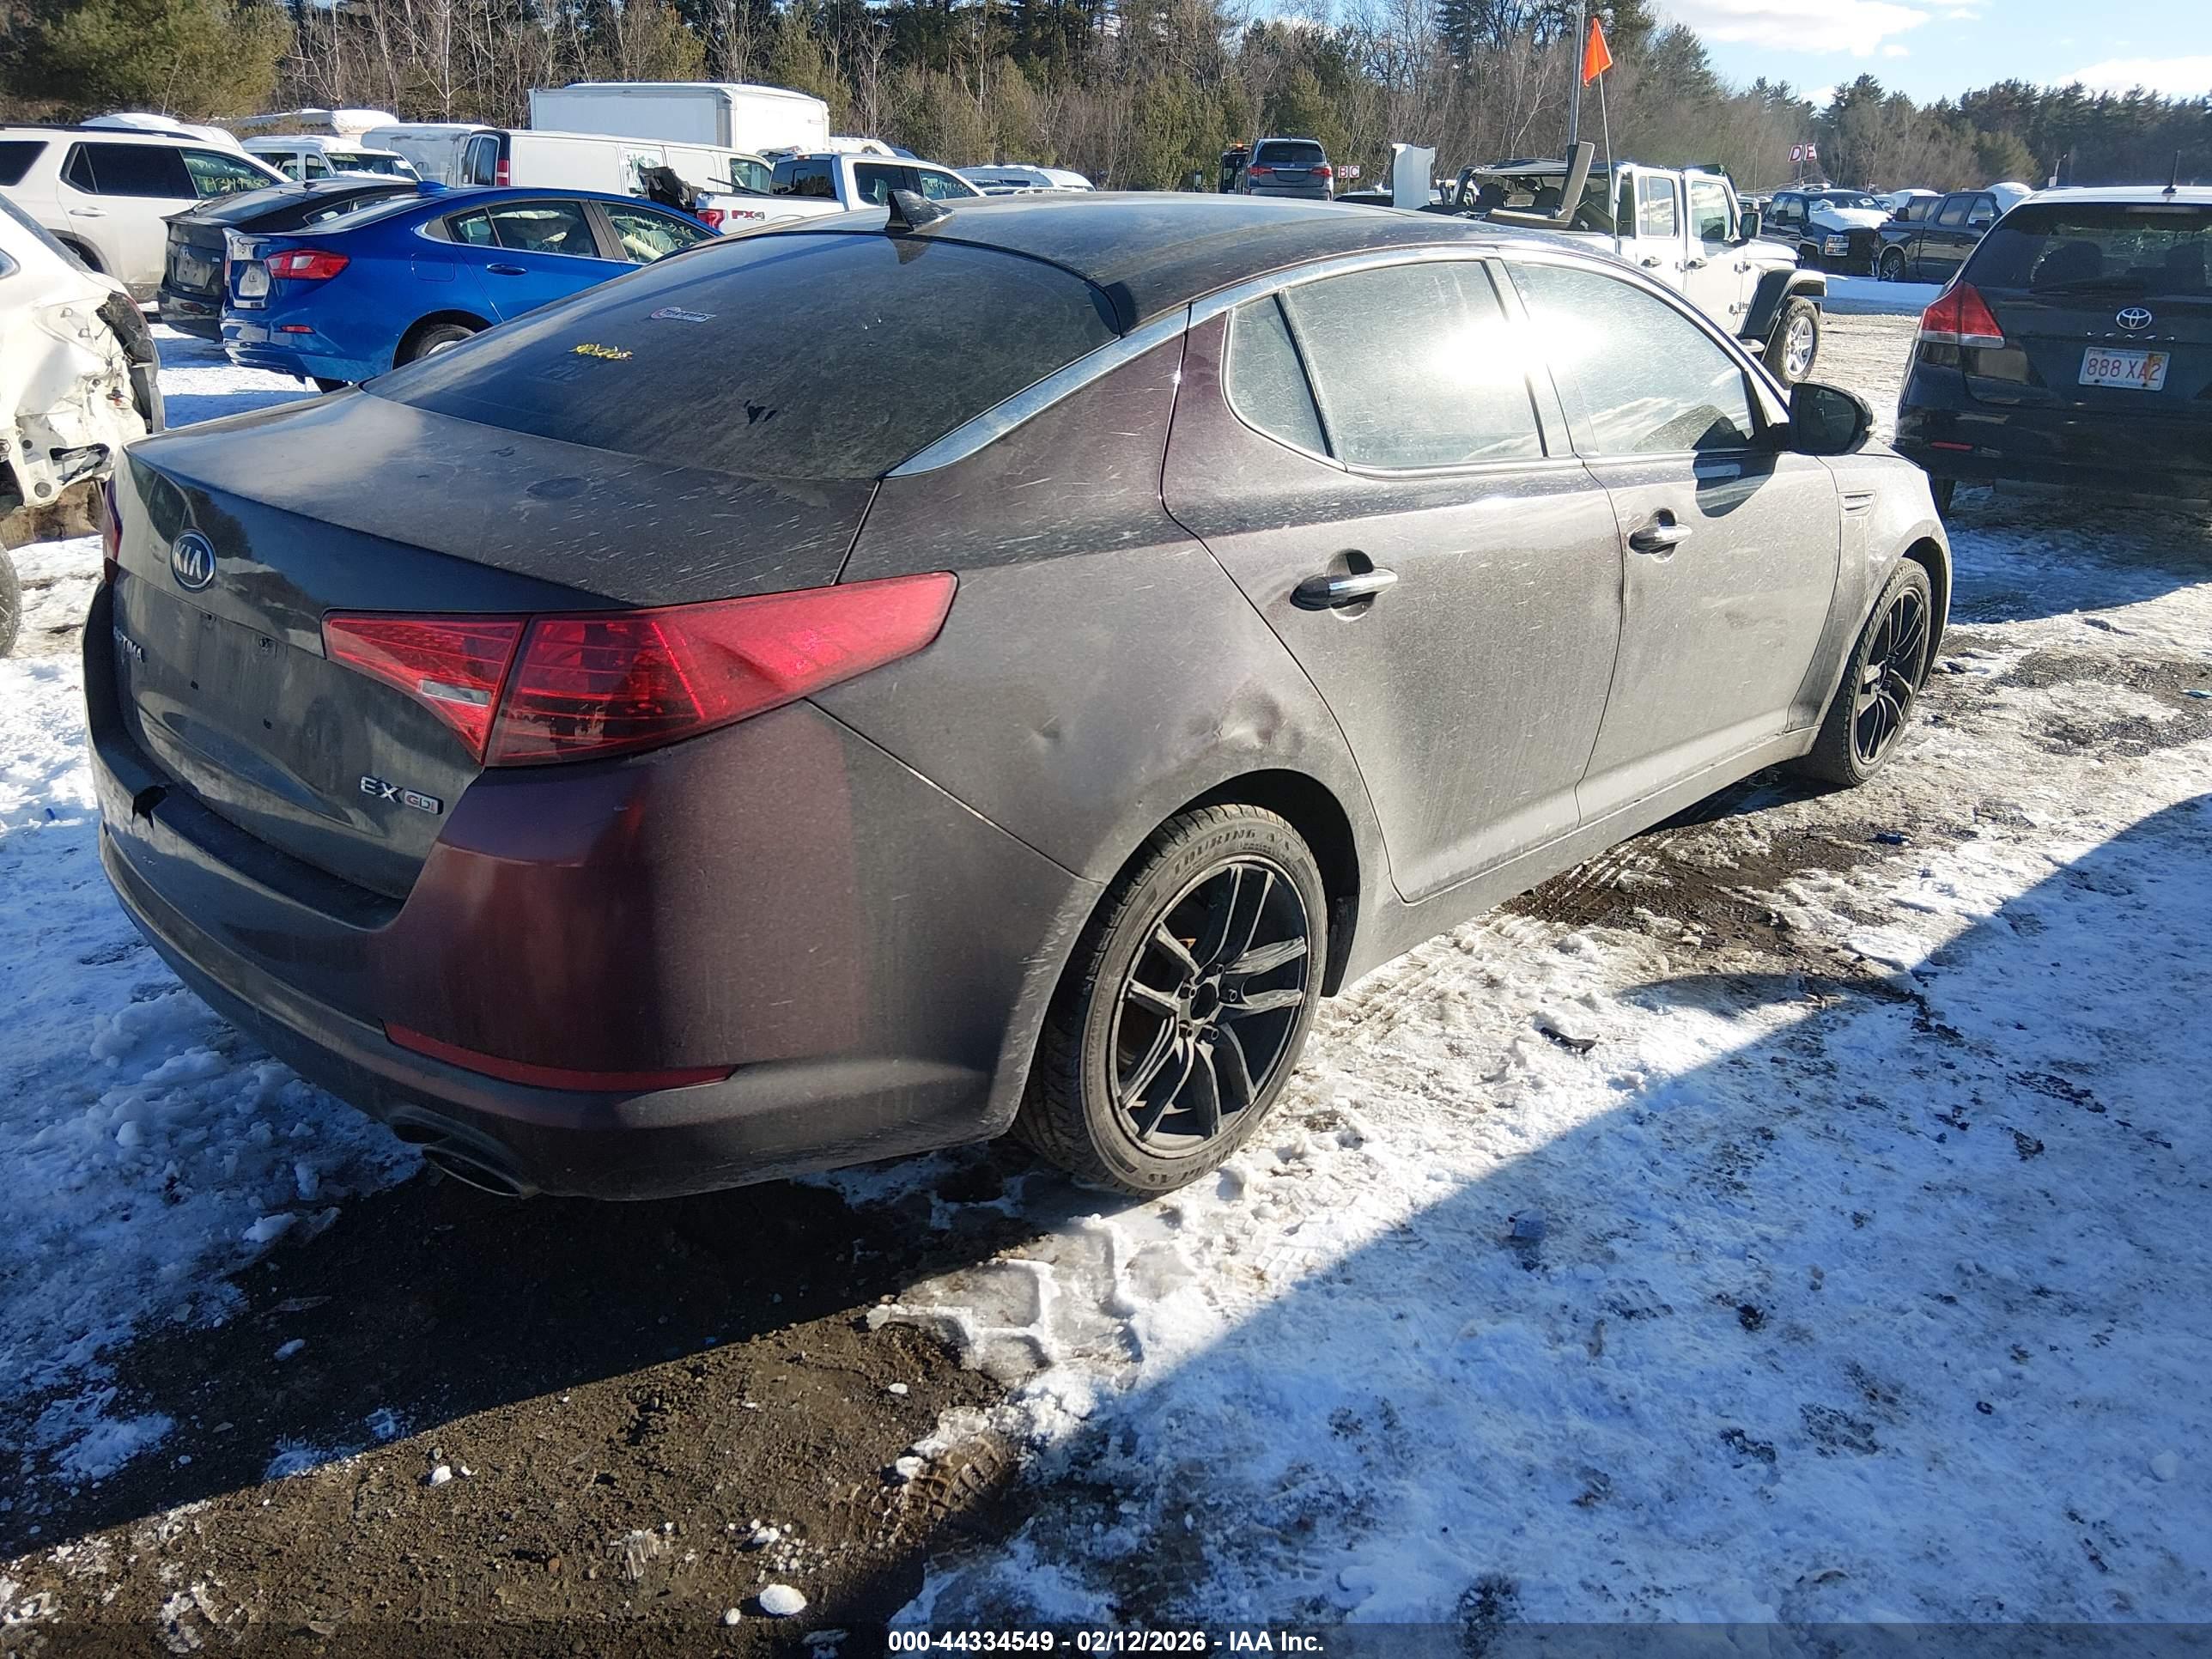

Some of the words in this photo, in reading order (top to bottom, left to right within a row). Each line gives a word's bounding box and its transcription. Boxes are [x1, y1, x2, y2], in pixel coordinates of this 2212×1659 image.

[732, 210, 765, 221] FX4
[2087, 358, 2122, 377] 888
[2126, 361, 2161, 380] XA2
[174, 542, 204, 580] KIA
[361, 776, 399, 803] EX
[406, 794, 436, 812] GDI
